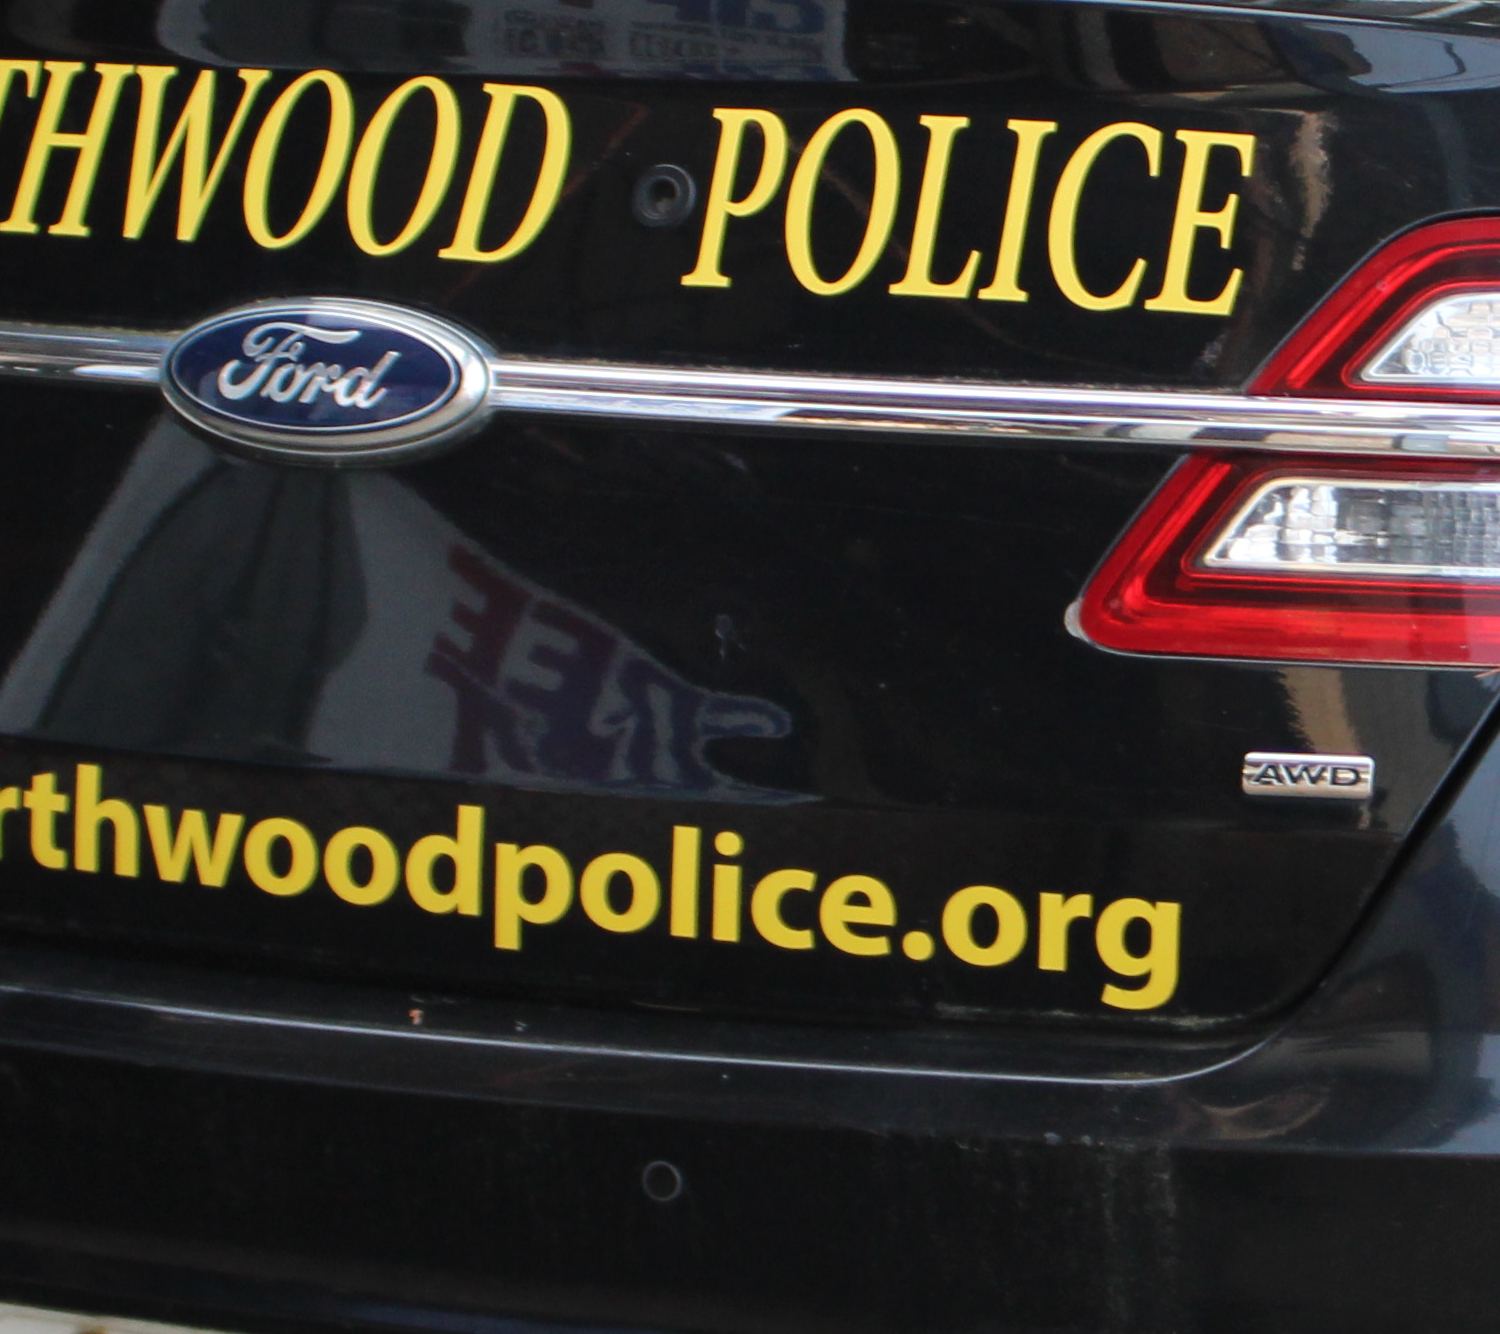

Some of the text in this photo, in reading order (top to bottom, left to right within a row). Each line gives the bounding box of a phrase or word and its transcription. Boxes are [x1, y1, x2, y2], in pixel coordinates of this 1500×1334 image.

[680, 107, 1257, 317] POLICE
[217, 321, 403, 410] Ford
[1251, 763, 1363, 788] AWD
